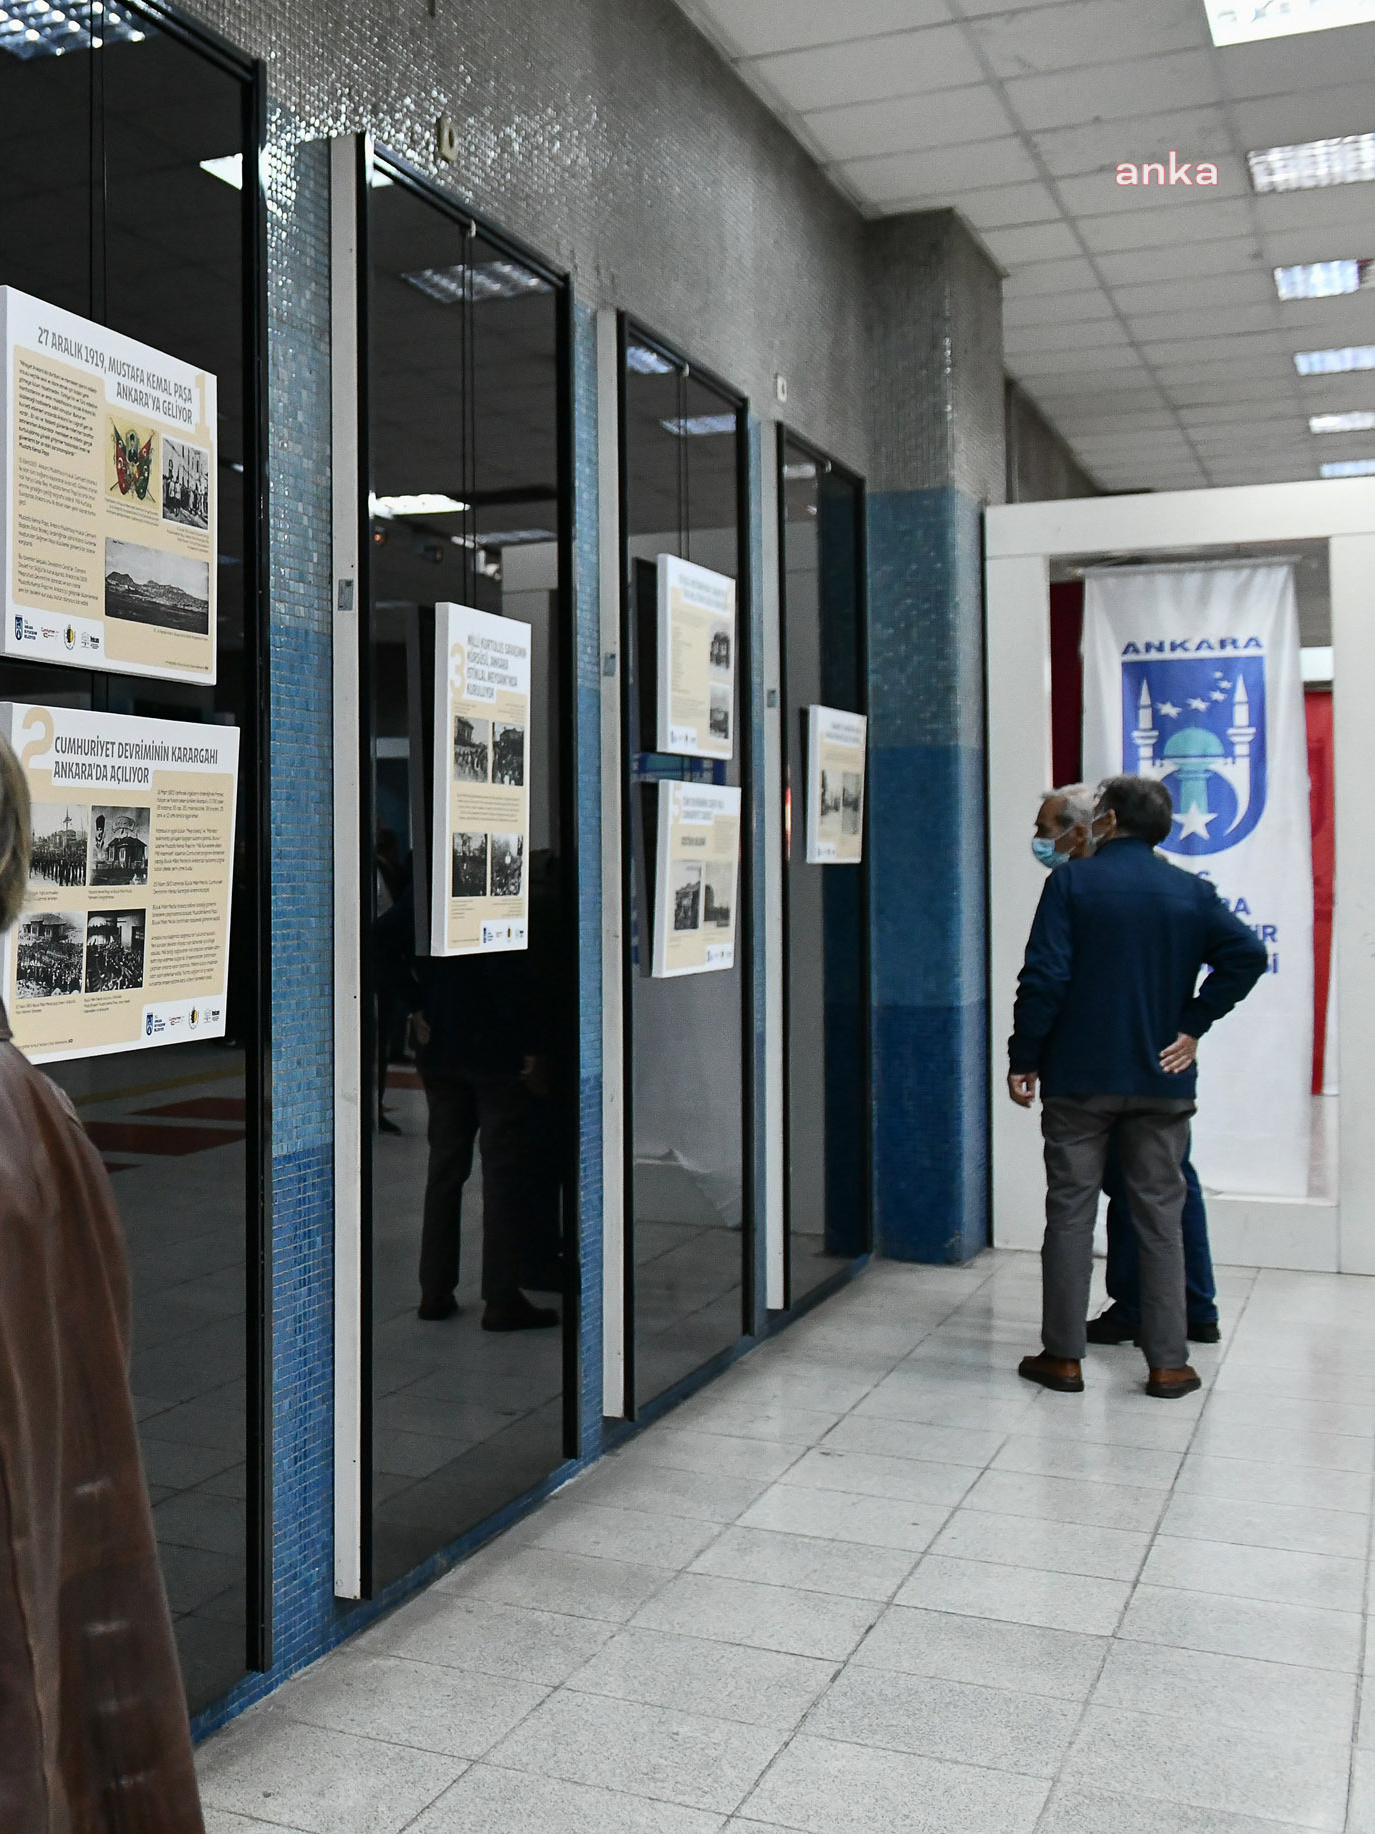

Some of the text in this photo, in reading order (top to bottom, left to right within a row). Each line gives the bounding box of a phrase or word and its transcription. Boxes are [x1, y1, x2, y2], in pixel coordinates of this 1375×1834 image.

[38, 326, 193, 404] 27 ARALIK 1919, MUSTAFA KEMAL PAŞA
[116, 381, 193, 425] ANKARA'YA GELİYOR
[1121, 636, 1265, 656] ANKARA
[54, 735, 218, 765] CUMHURİYET DEVRİMİNİN KARARGAHI
[53, 760, 150, 784] ANKARA'DA AÇILIYOR
